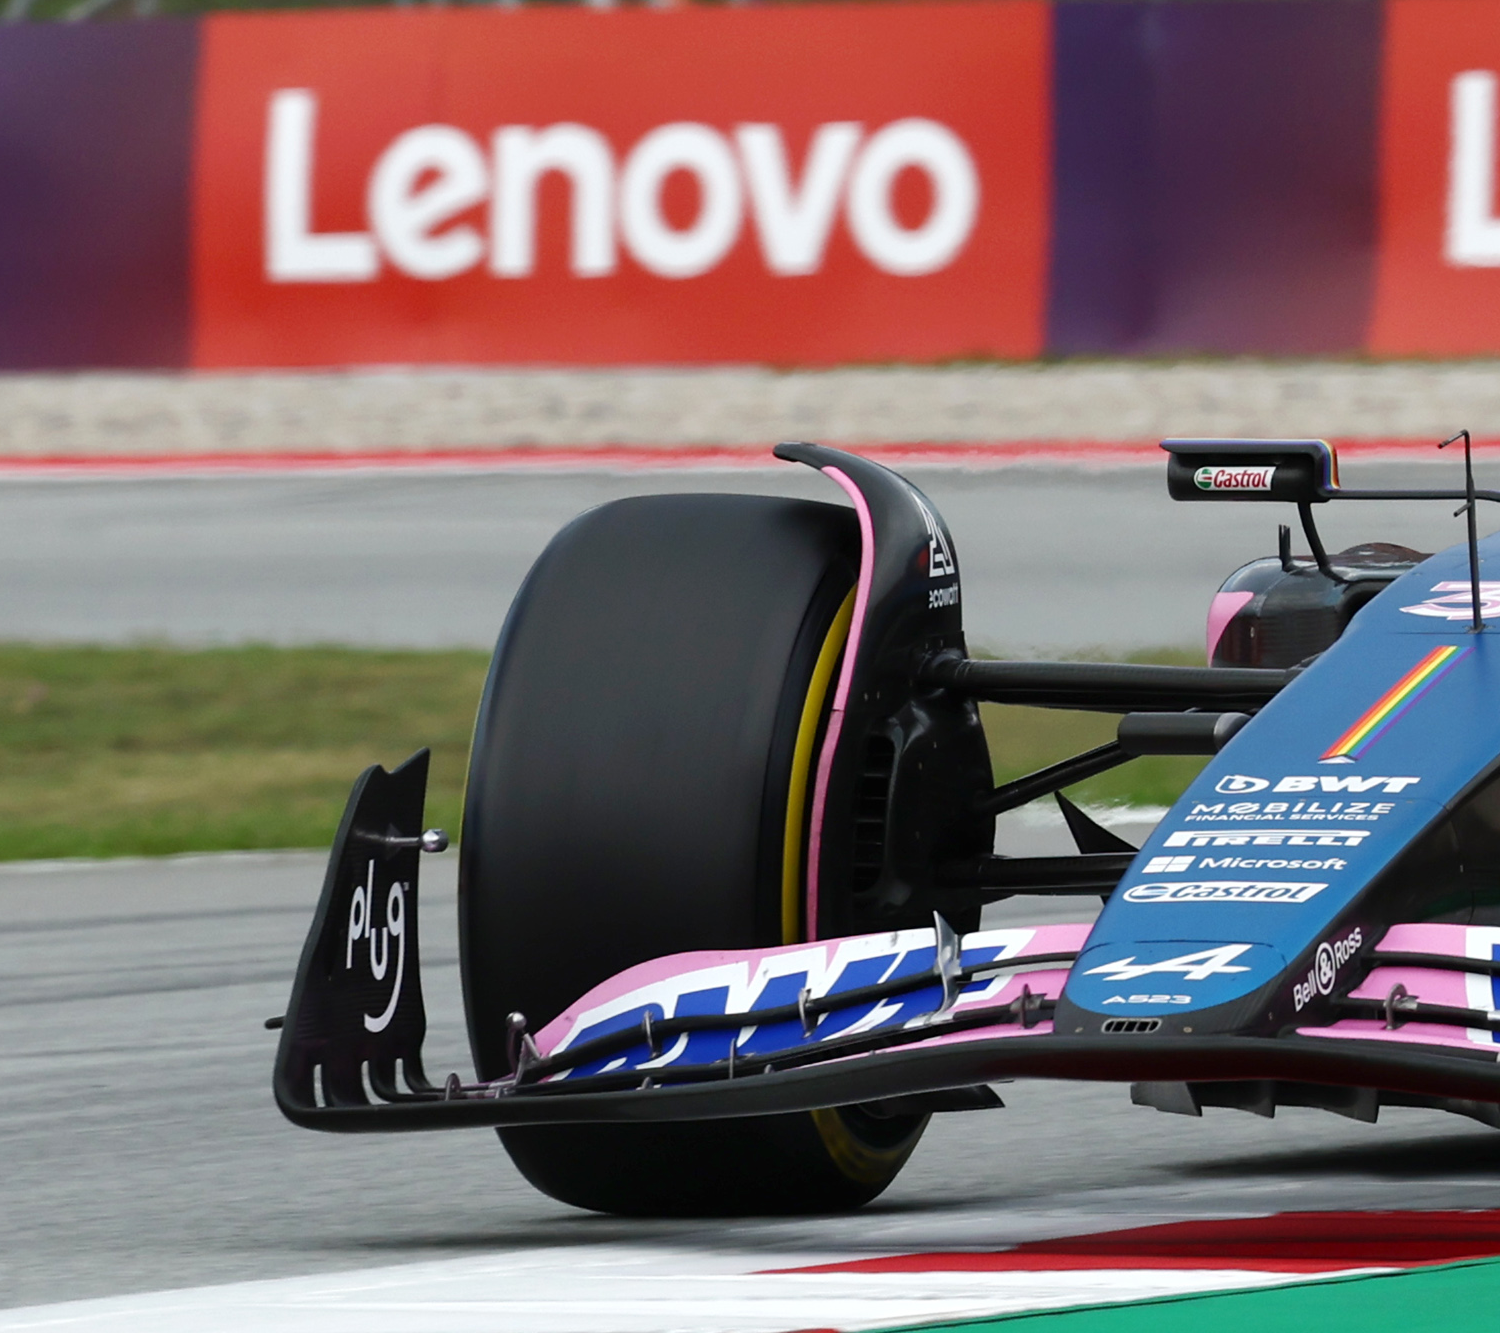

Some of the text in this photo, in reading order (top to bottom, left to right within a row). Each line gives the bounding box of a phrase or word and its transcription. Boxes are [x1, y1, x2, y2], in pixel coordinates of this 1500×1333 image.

[265, 87, 979, 283] Lenovo
[1214, 469, 1268, 489] Castrol
[1272, 775, 1421, 793] BWT
[1184, 813, 1380, 822] FINANCIAL SERVICES
[1163, 829, 1371, 847] PIRELLI
[1199, 856, 1347, 870] Microsoft
[1168, 884, 1315, 900] Castrol
[346, 859, 406, 1033] plug
[1293, 927, 1363, 1012] Bell & Ross
[1102, 994, 1192, 1004] A523
